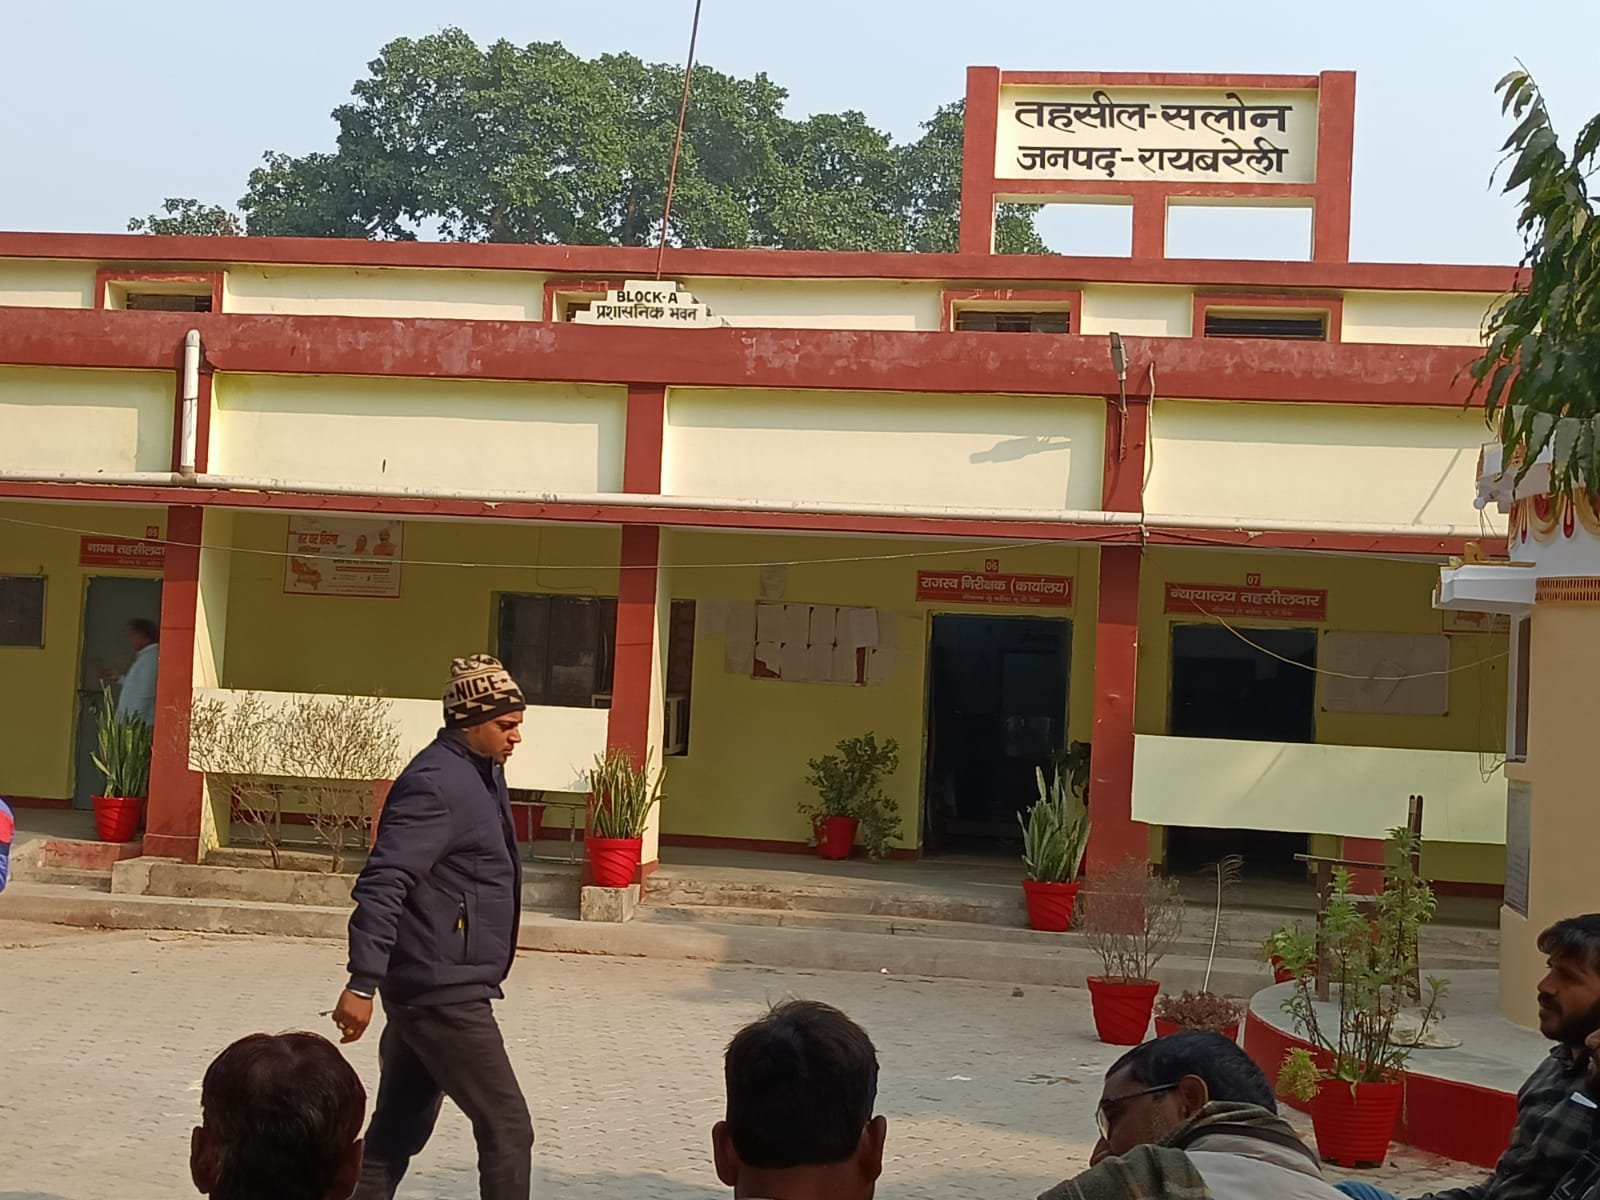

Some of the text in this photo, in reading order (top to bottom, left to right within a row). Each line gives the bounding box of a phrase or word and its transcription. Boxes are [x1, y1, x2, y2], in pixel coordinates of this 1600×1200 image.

[1014, 90, 1293, 135] तहसील-सलोन
[1016, 136, 1289, 178] जनपद-रायबरेली
[616, 290, 678, 304] BLOCK-A
[596, 303, 698, 321] प्रशासनिक भवन
[117, 542, 165, 556] तहसीलदा
[986, 561, 998, 571] 06
[921, 576, 959, 589] राजस्व
[961, 575, 1006, 592] निरीक्षक
[1010, 577, 1069, 598] (कार्यालय)
[1247, 575, 1259, 585] 07
[1170, 588, 1320, 607] न्यायालय तहसीलदार
[455, 674, 502, 701] NICE
